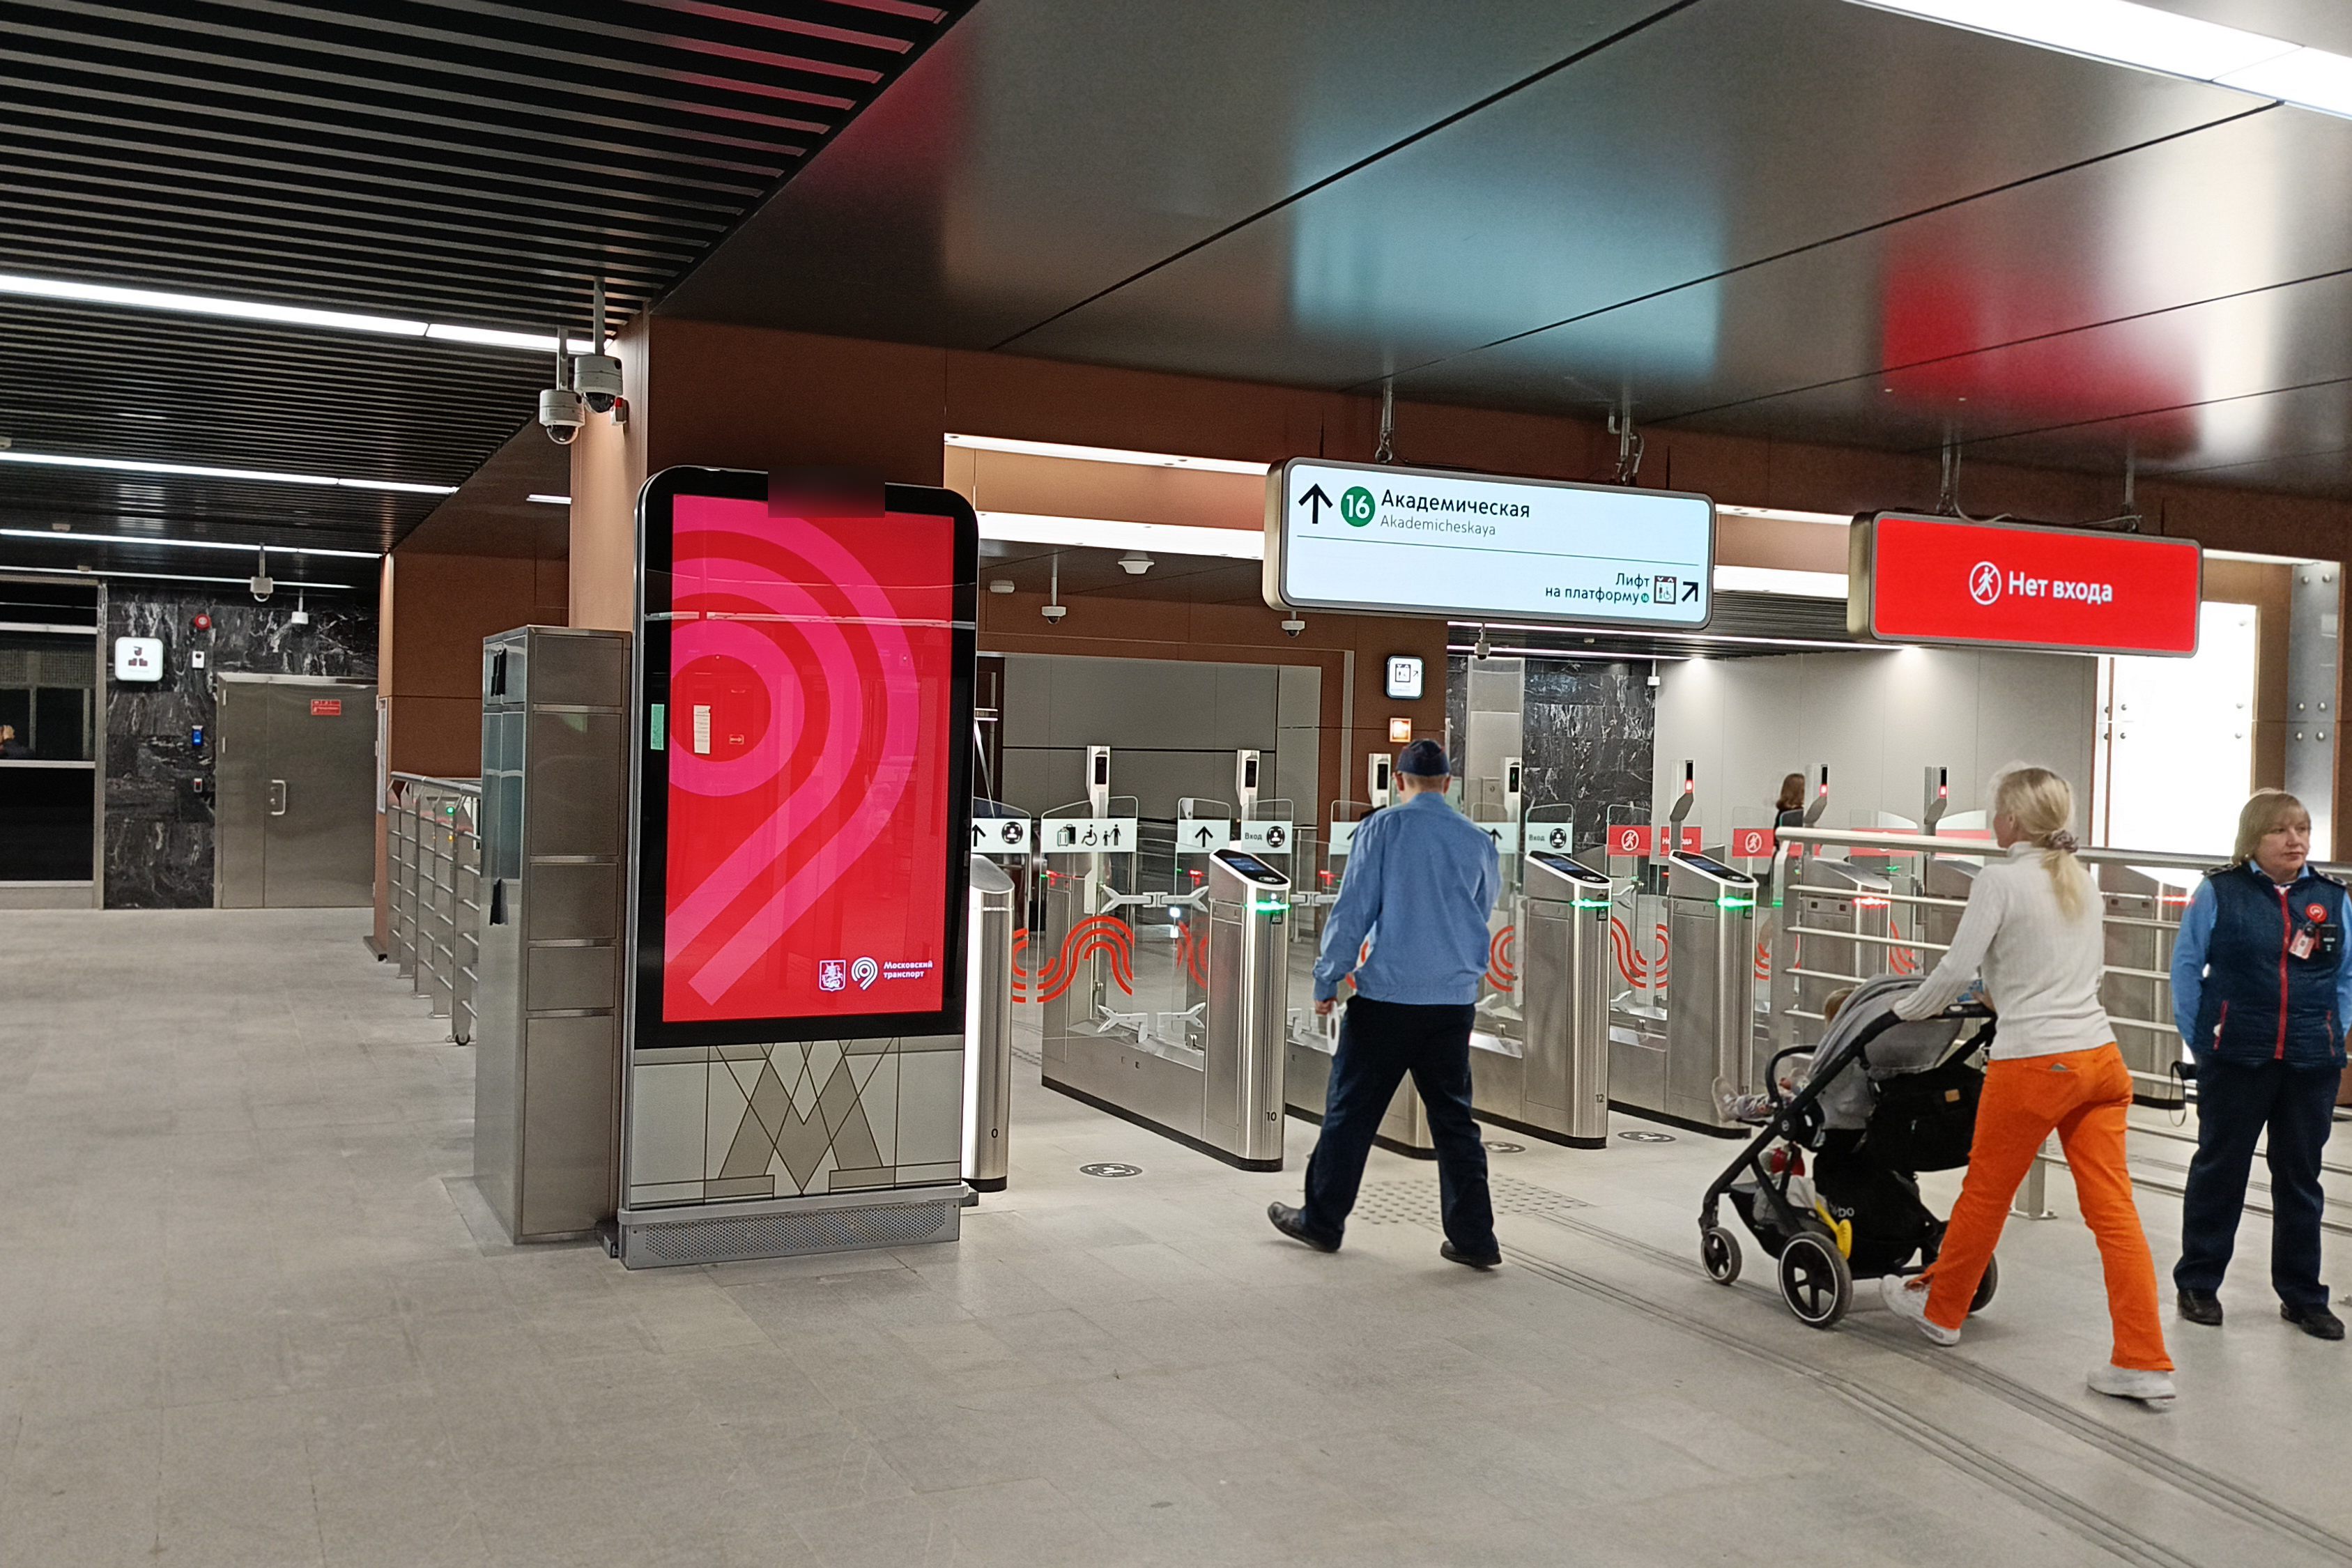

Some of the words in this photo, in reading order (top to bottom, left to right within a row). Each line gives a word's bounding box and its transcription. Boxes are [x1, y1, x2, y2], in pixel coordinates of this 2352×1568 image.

[1346, 495, 1370, 518] 16
[1381, 489, 1530, 518] Академическая
[1381, 515, 1496, 537] Akademicheskaya
[1615, 573, 1650, 589] Лифт
[2008, 571, 2048, 597] Нет
[2052, 581, 2113, 605] входа
[1546, 587, 1560, 597] на
[1565, 587, 1639, 605] платформу
[1245, 832, 1263, 840] Вход
[884, 960, 932, 969] Московский
[883, 971, 924, 980] транспорт
[1596, 1093, 1605, 1103] 12
[1266, 1112, 1277, 1121] 10
